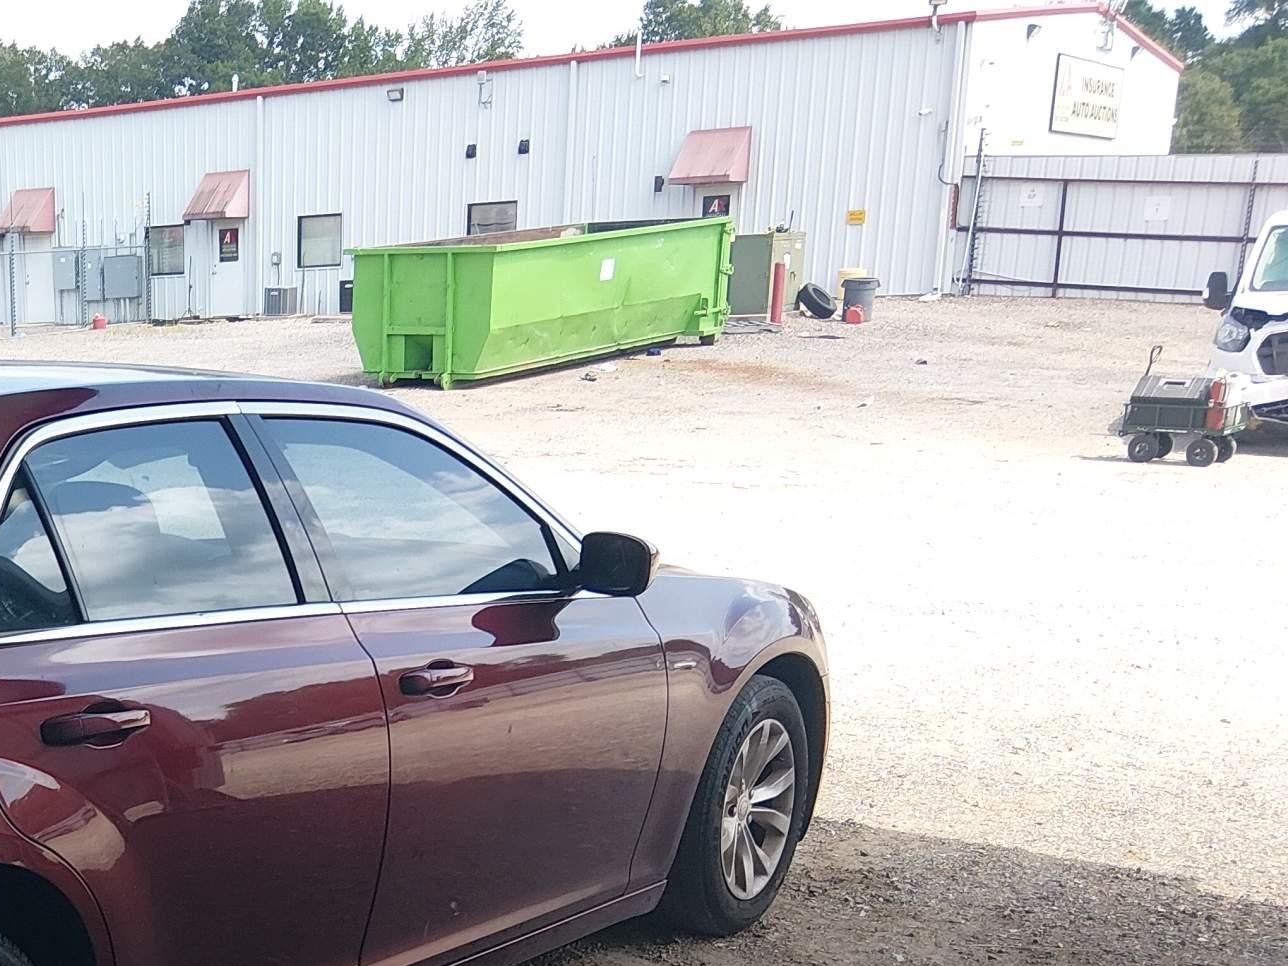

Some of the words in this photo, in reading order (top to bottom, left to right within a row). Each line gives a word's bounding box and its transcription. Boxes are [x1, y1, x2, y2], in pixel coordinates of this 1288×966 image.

[1081, 77, 1115, 98] INSURANCE
[1071, 101, 1090, 119] AUTO
[1089, 103, 1118, 124] AUCTIONS
